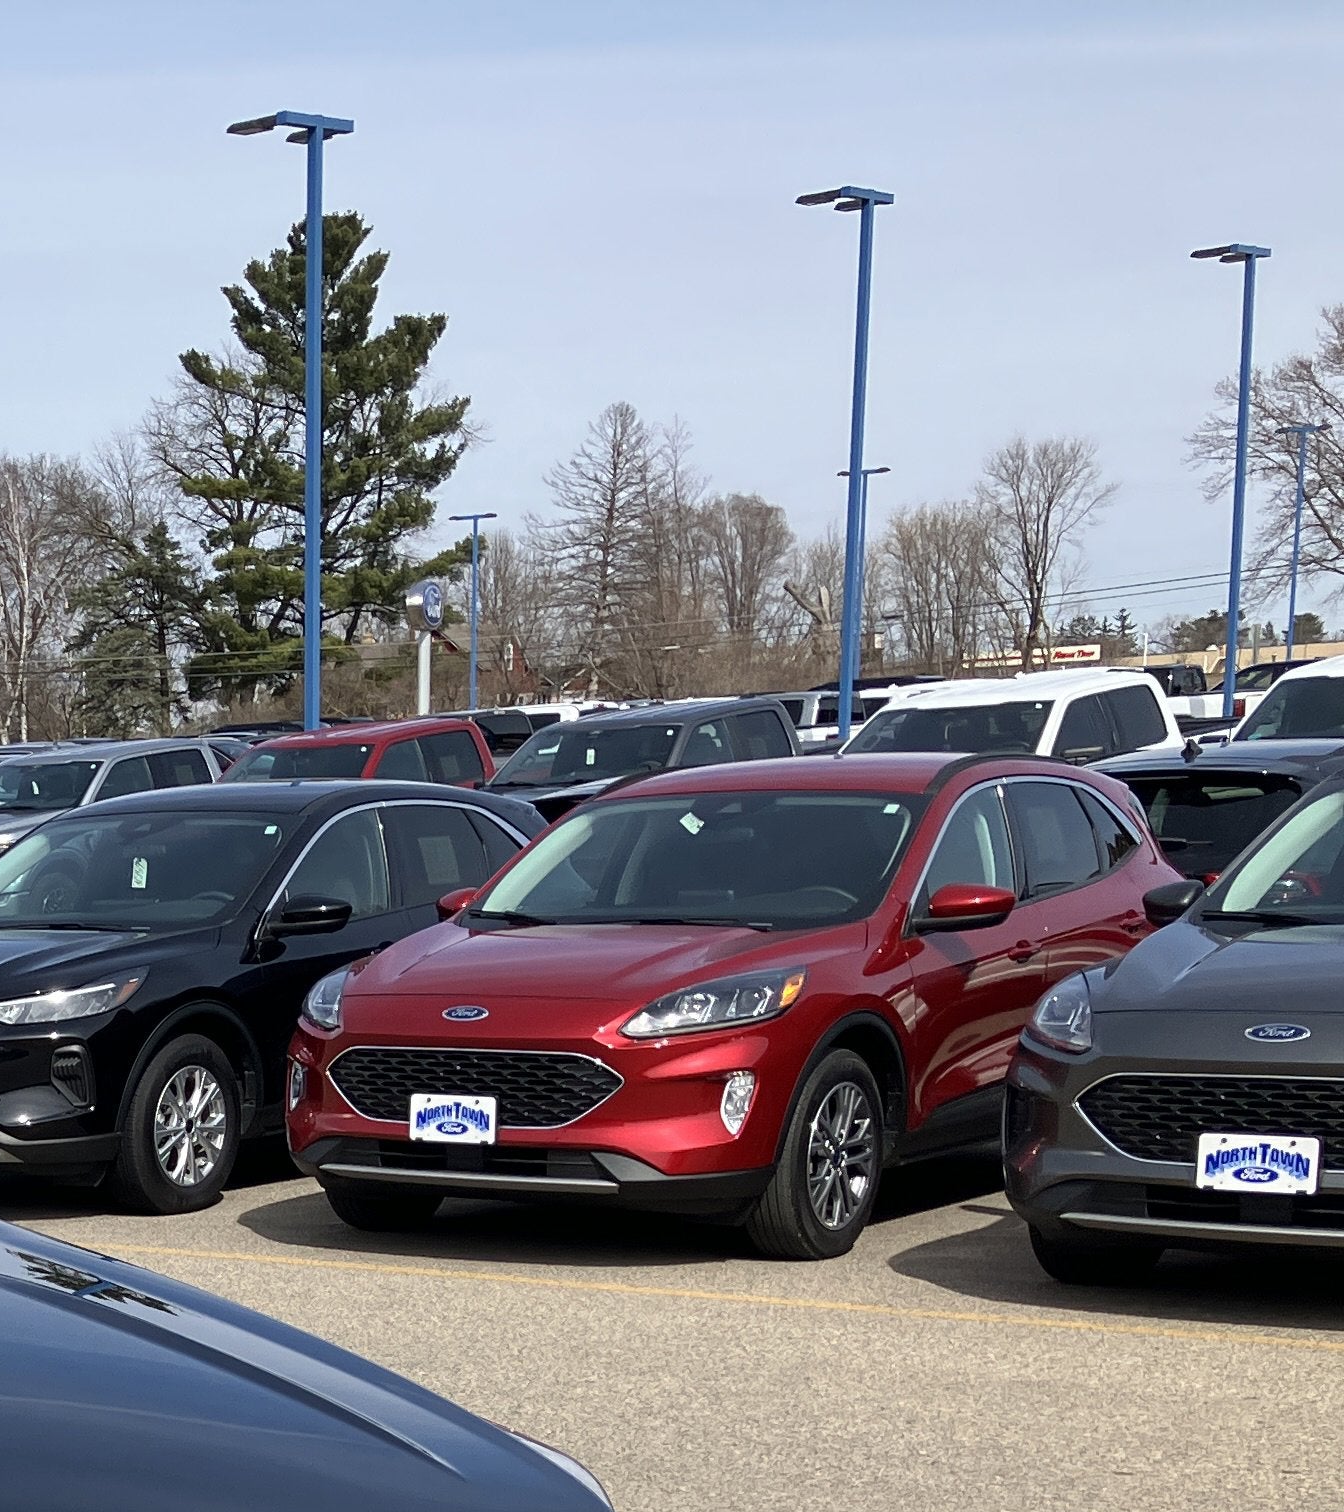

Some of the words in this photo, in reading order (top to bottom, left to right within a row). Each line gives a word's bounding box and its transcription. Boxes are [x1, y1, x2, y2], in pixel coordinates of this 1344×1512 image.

[451, 1007, 478, 1017] Ford
[1258, 1024, 1295, 1037] Ford
[441, 1122, 463, 1133] Ford
[1205, 1146, 1257, 1176] NORTH
[1258, 1143, 1310, 1179] TOWN
[1240, 1168, 1271, 1181] Ford
